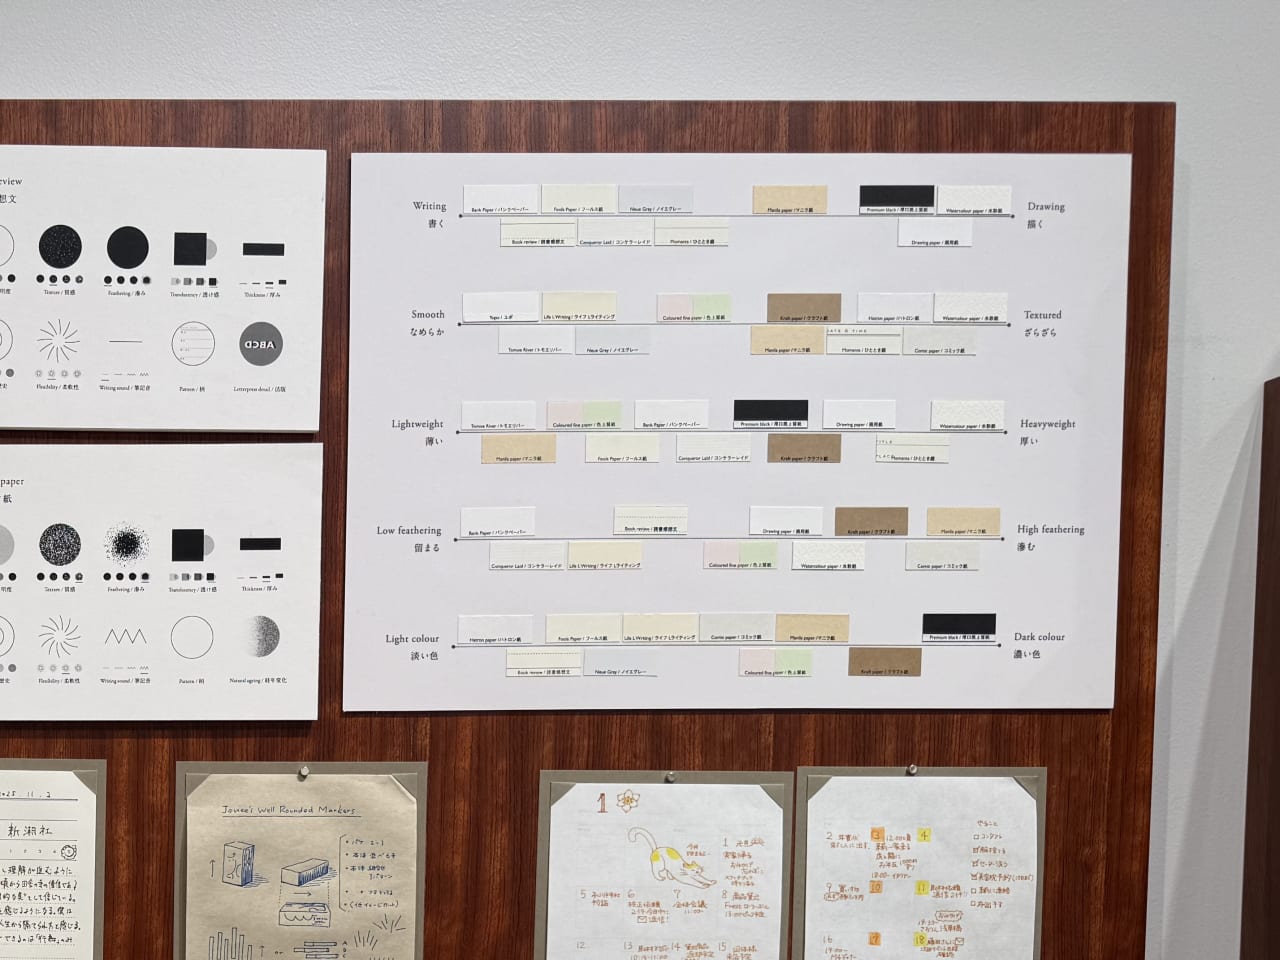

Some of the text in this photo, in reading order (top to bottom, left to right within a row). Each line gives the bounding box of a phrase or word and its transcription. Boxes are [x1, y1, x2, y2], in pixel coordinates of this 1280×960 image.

[413, 201, 447, 212] Writing
[1028, 201, 1065, 213] Drawing
[428, 218, 445, 229] 書く
[1027, 219, 1044, 230] 描く
[411, 309, 445, 320] Smooth
[1024, 310, 1062, 320] Textured
[410, 327, 445, 337] なめらか
[1024, 327, 1058, 338] ざらざら
[392, 419, 443, 430] Lightweight
[1020, 418, 1076, 430] Heavyweight
[425, 437, 443, 446] 薄い
[1020, 437, 1039, 446] 厚い
[0, 478, 24, 487] paper
[377, 525, 442, 537] Low feathering
[1017, 524, 1085, 536] High feathering
[414, 543, 440, 553] 留まる
[385, 634, 440, 645] Light colour
[1014, 632, 1065, 642] Dark colour
[411, 651, 439, 661] 淡い色
[1013, 650, 1041, 659] 濃い色
[596, 792, 608, 813] 1
[319, 805, 356, 814] Markers
[8, 823, 53, 837] 新潮社
[576, 942, 586, 951] 12
